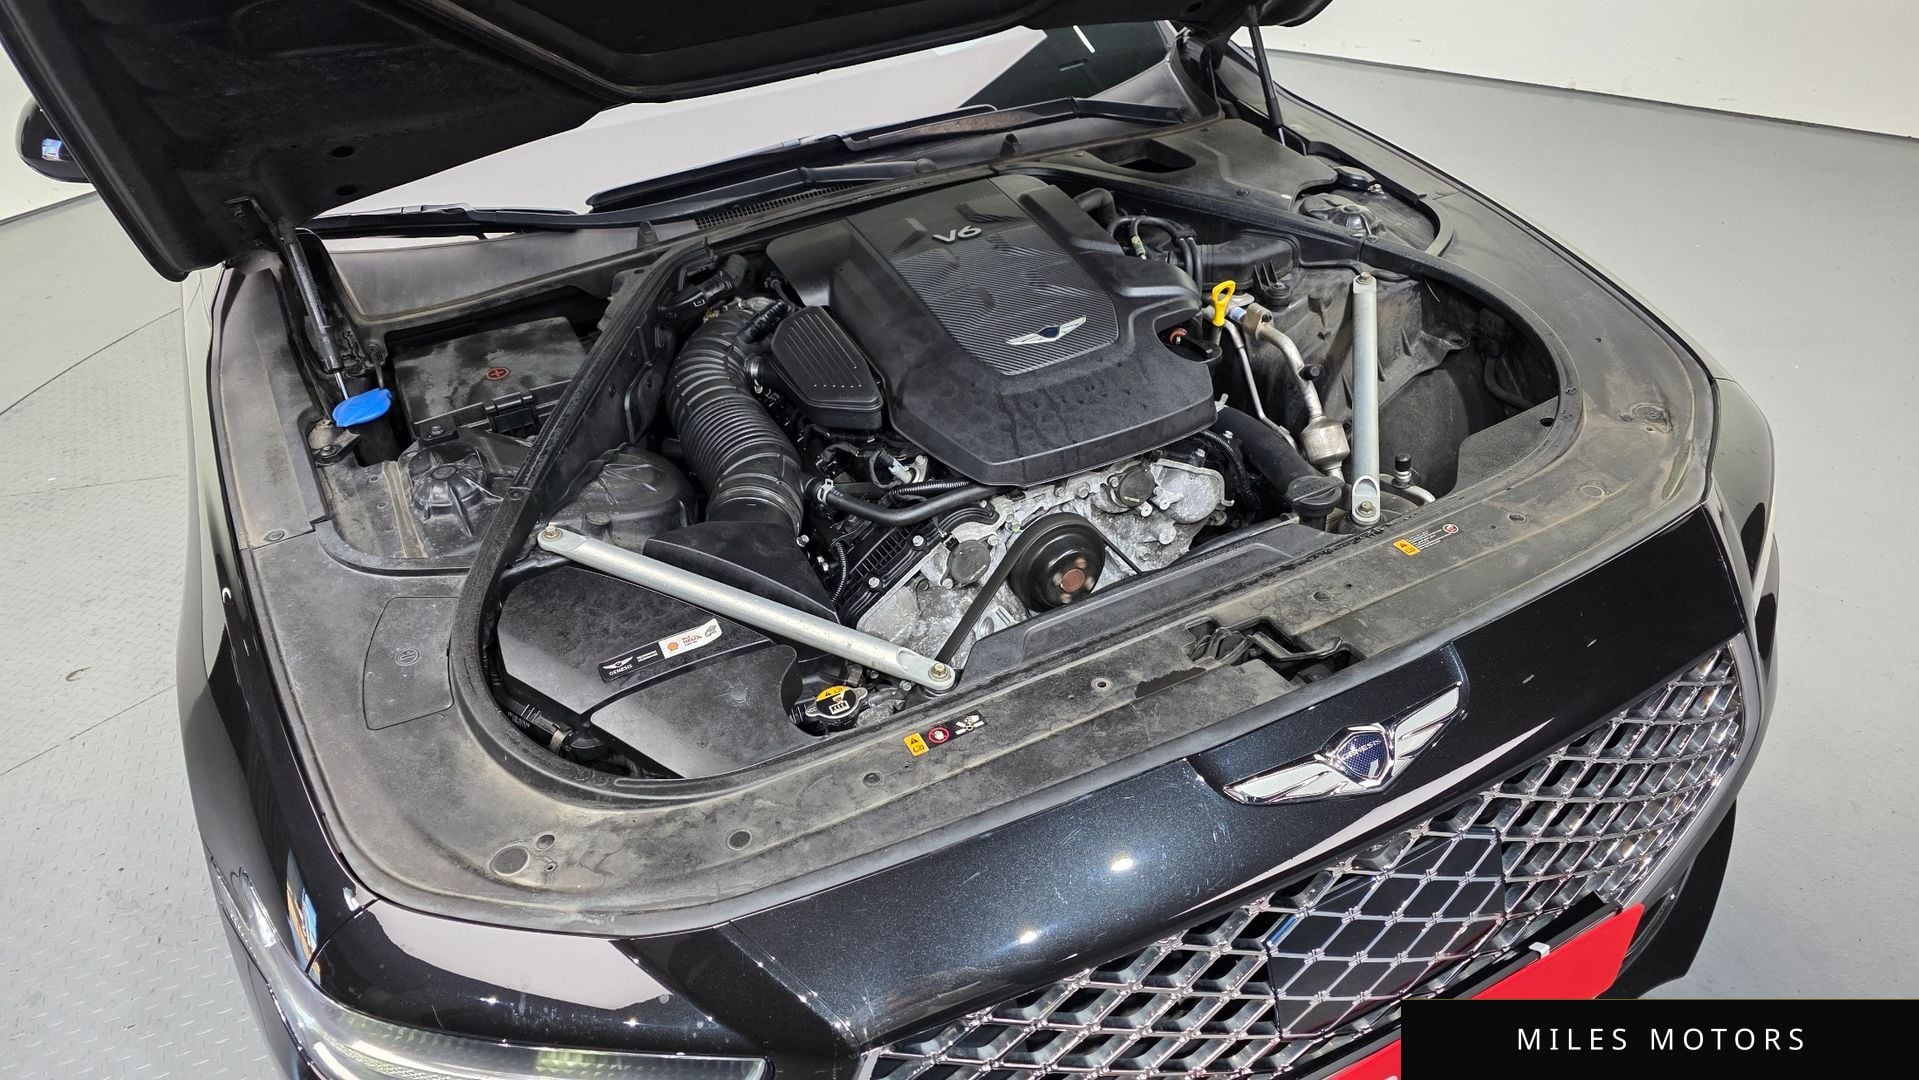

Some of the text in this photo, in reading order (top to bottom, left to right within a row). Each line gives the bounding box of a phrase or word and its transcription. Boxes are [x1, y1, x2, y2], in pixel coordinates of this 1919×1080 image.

[932, 225, 982, 244] V6
[609, 664, 633, 676] GENESIS
[1342, 740, 1381, 760] GENESIS
